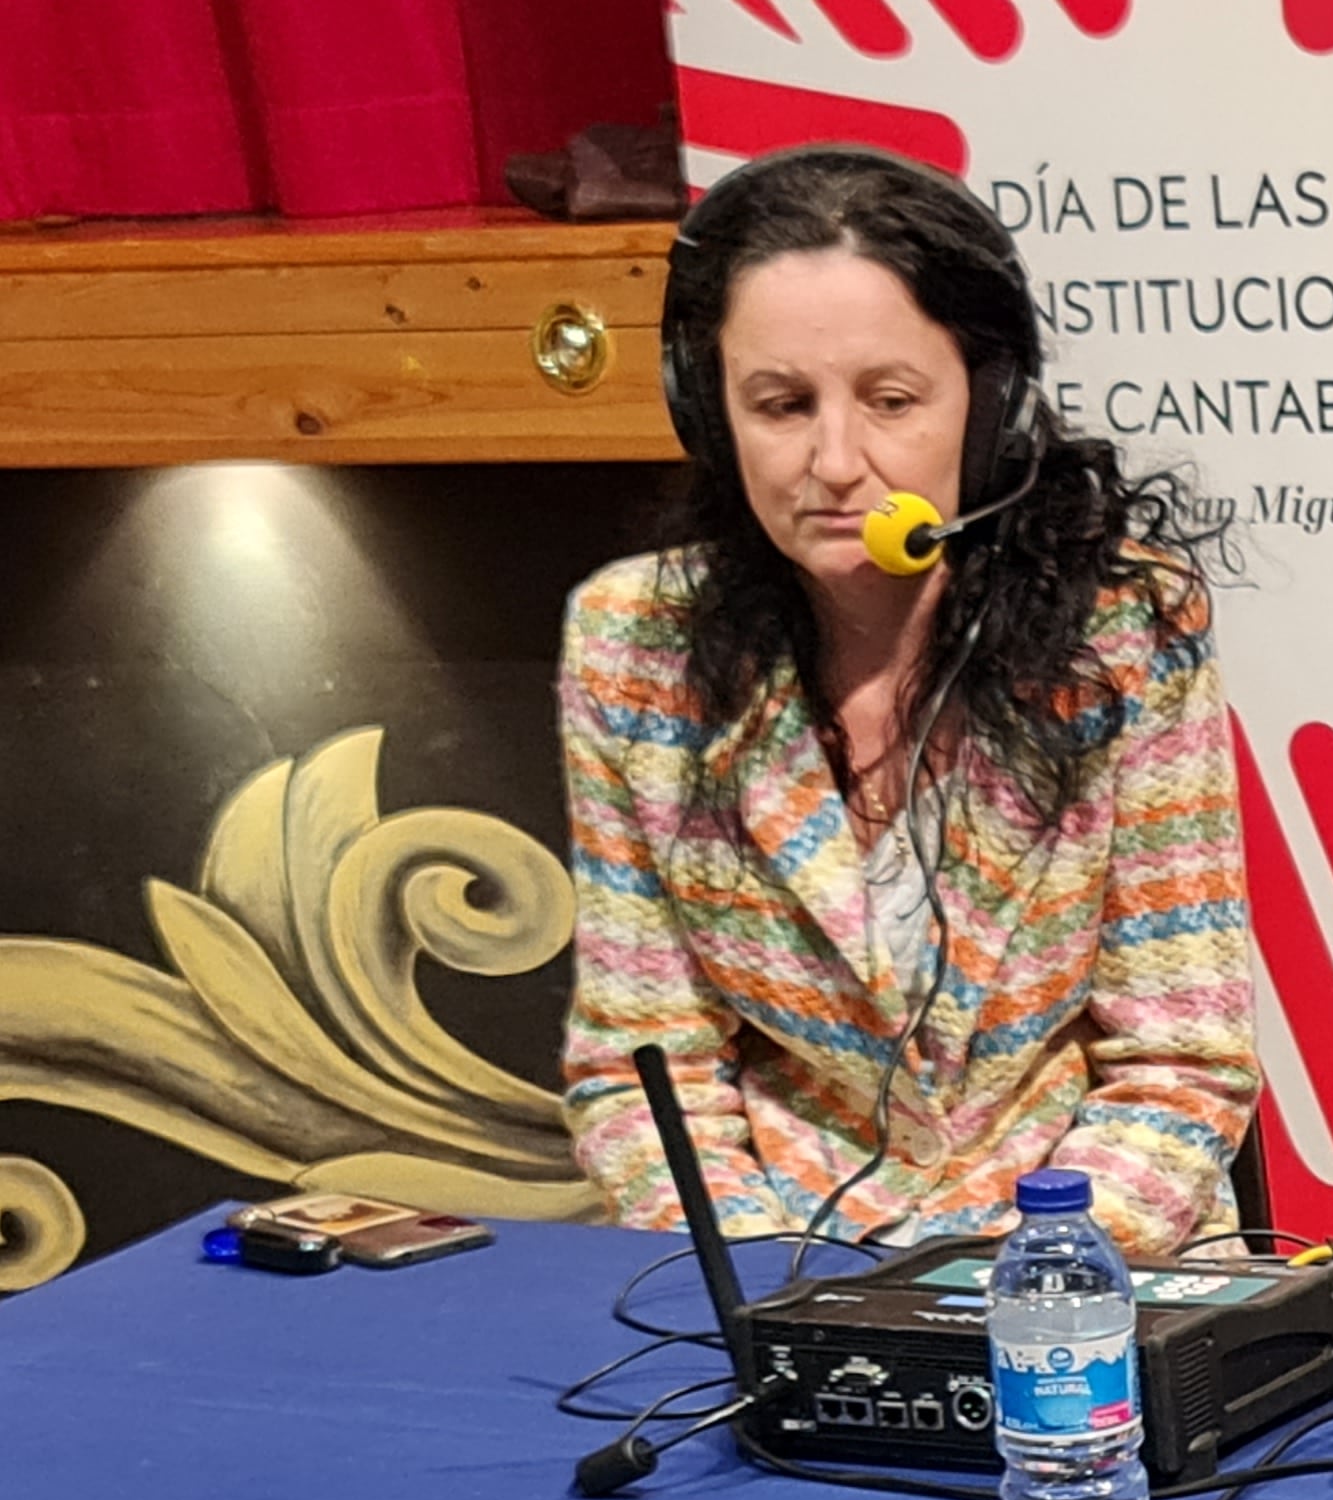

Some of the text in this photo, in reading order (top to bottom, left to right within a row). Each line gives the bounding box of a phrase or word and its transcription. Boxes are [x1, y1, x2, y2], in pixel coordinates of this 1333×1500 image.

[991, 162, 1330, 234] DÍA DE LAS
[1056, 381, 1085, 434] E
